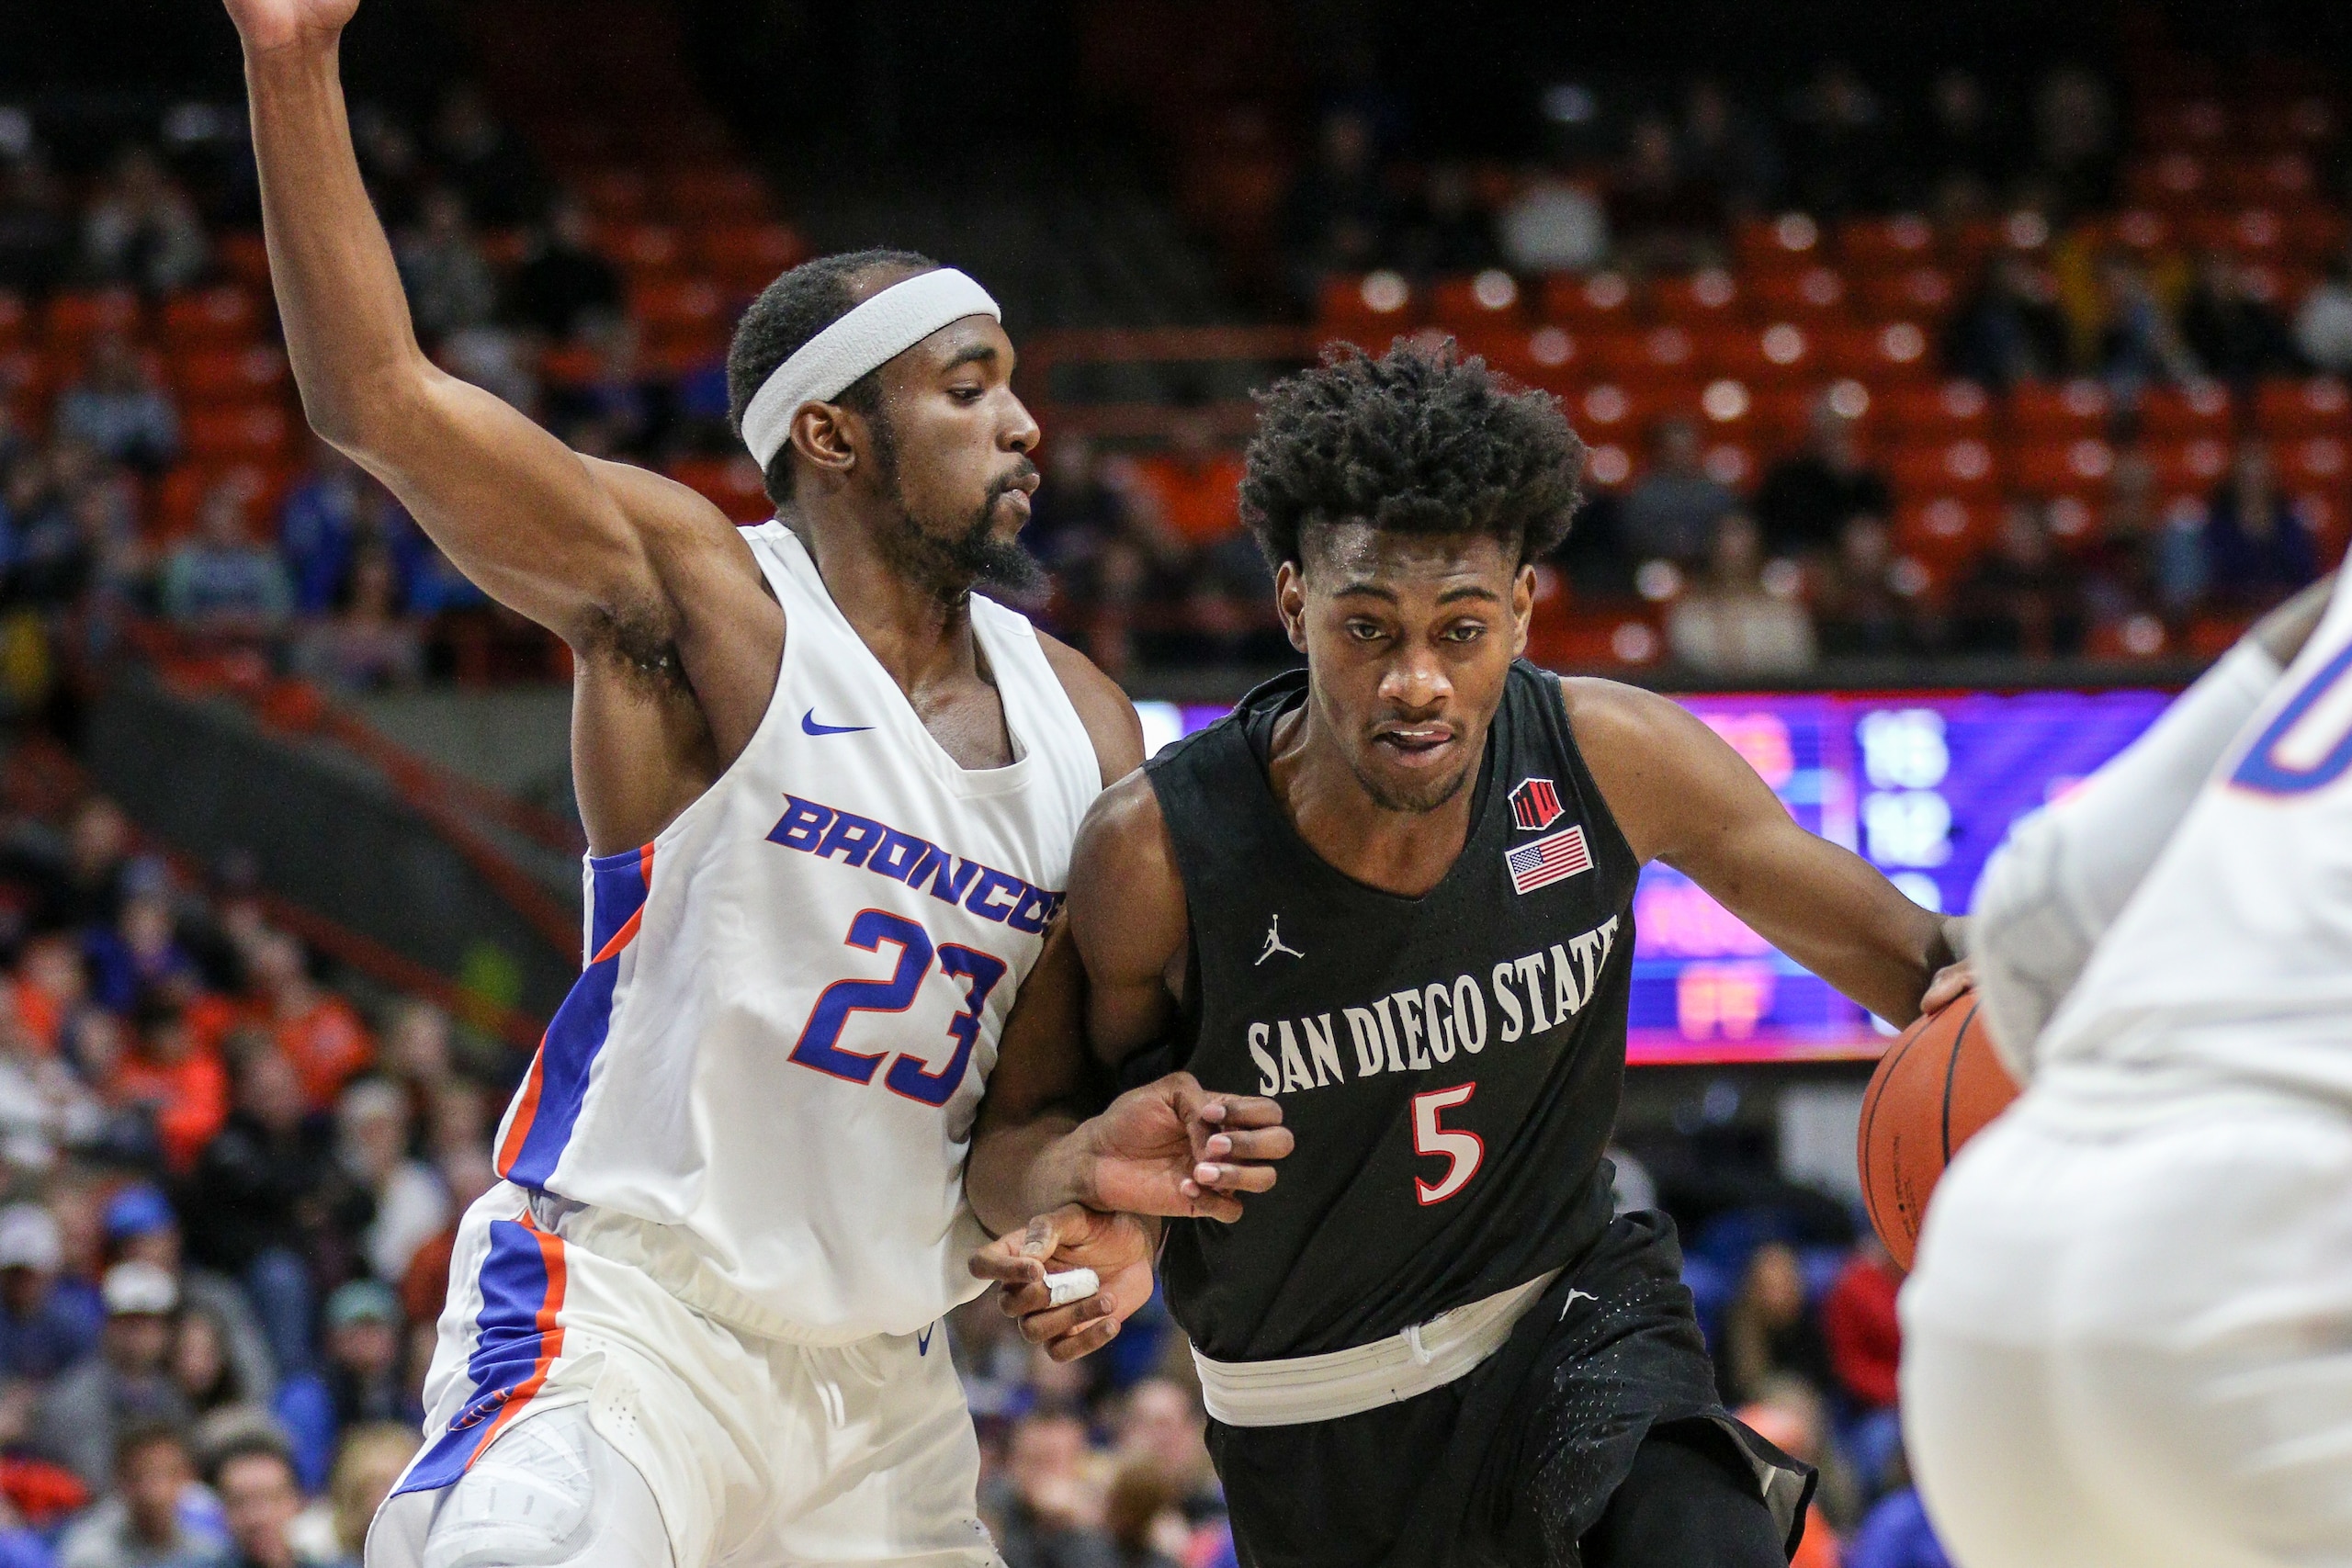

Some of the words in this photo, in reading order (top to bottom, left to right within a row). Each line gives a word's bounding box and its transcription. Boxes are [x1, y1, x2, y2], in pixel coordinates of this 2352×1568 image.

[787, 908, 1008, 1109] 23
[1248, 1013, 1345, 1097] SAN
[1342, 974, 1487, 1077] DIEGO
[1410, 1081, 1485, 1206] 5
